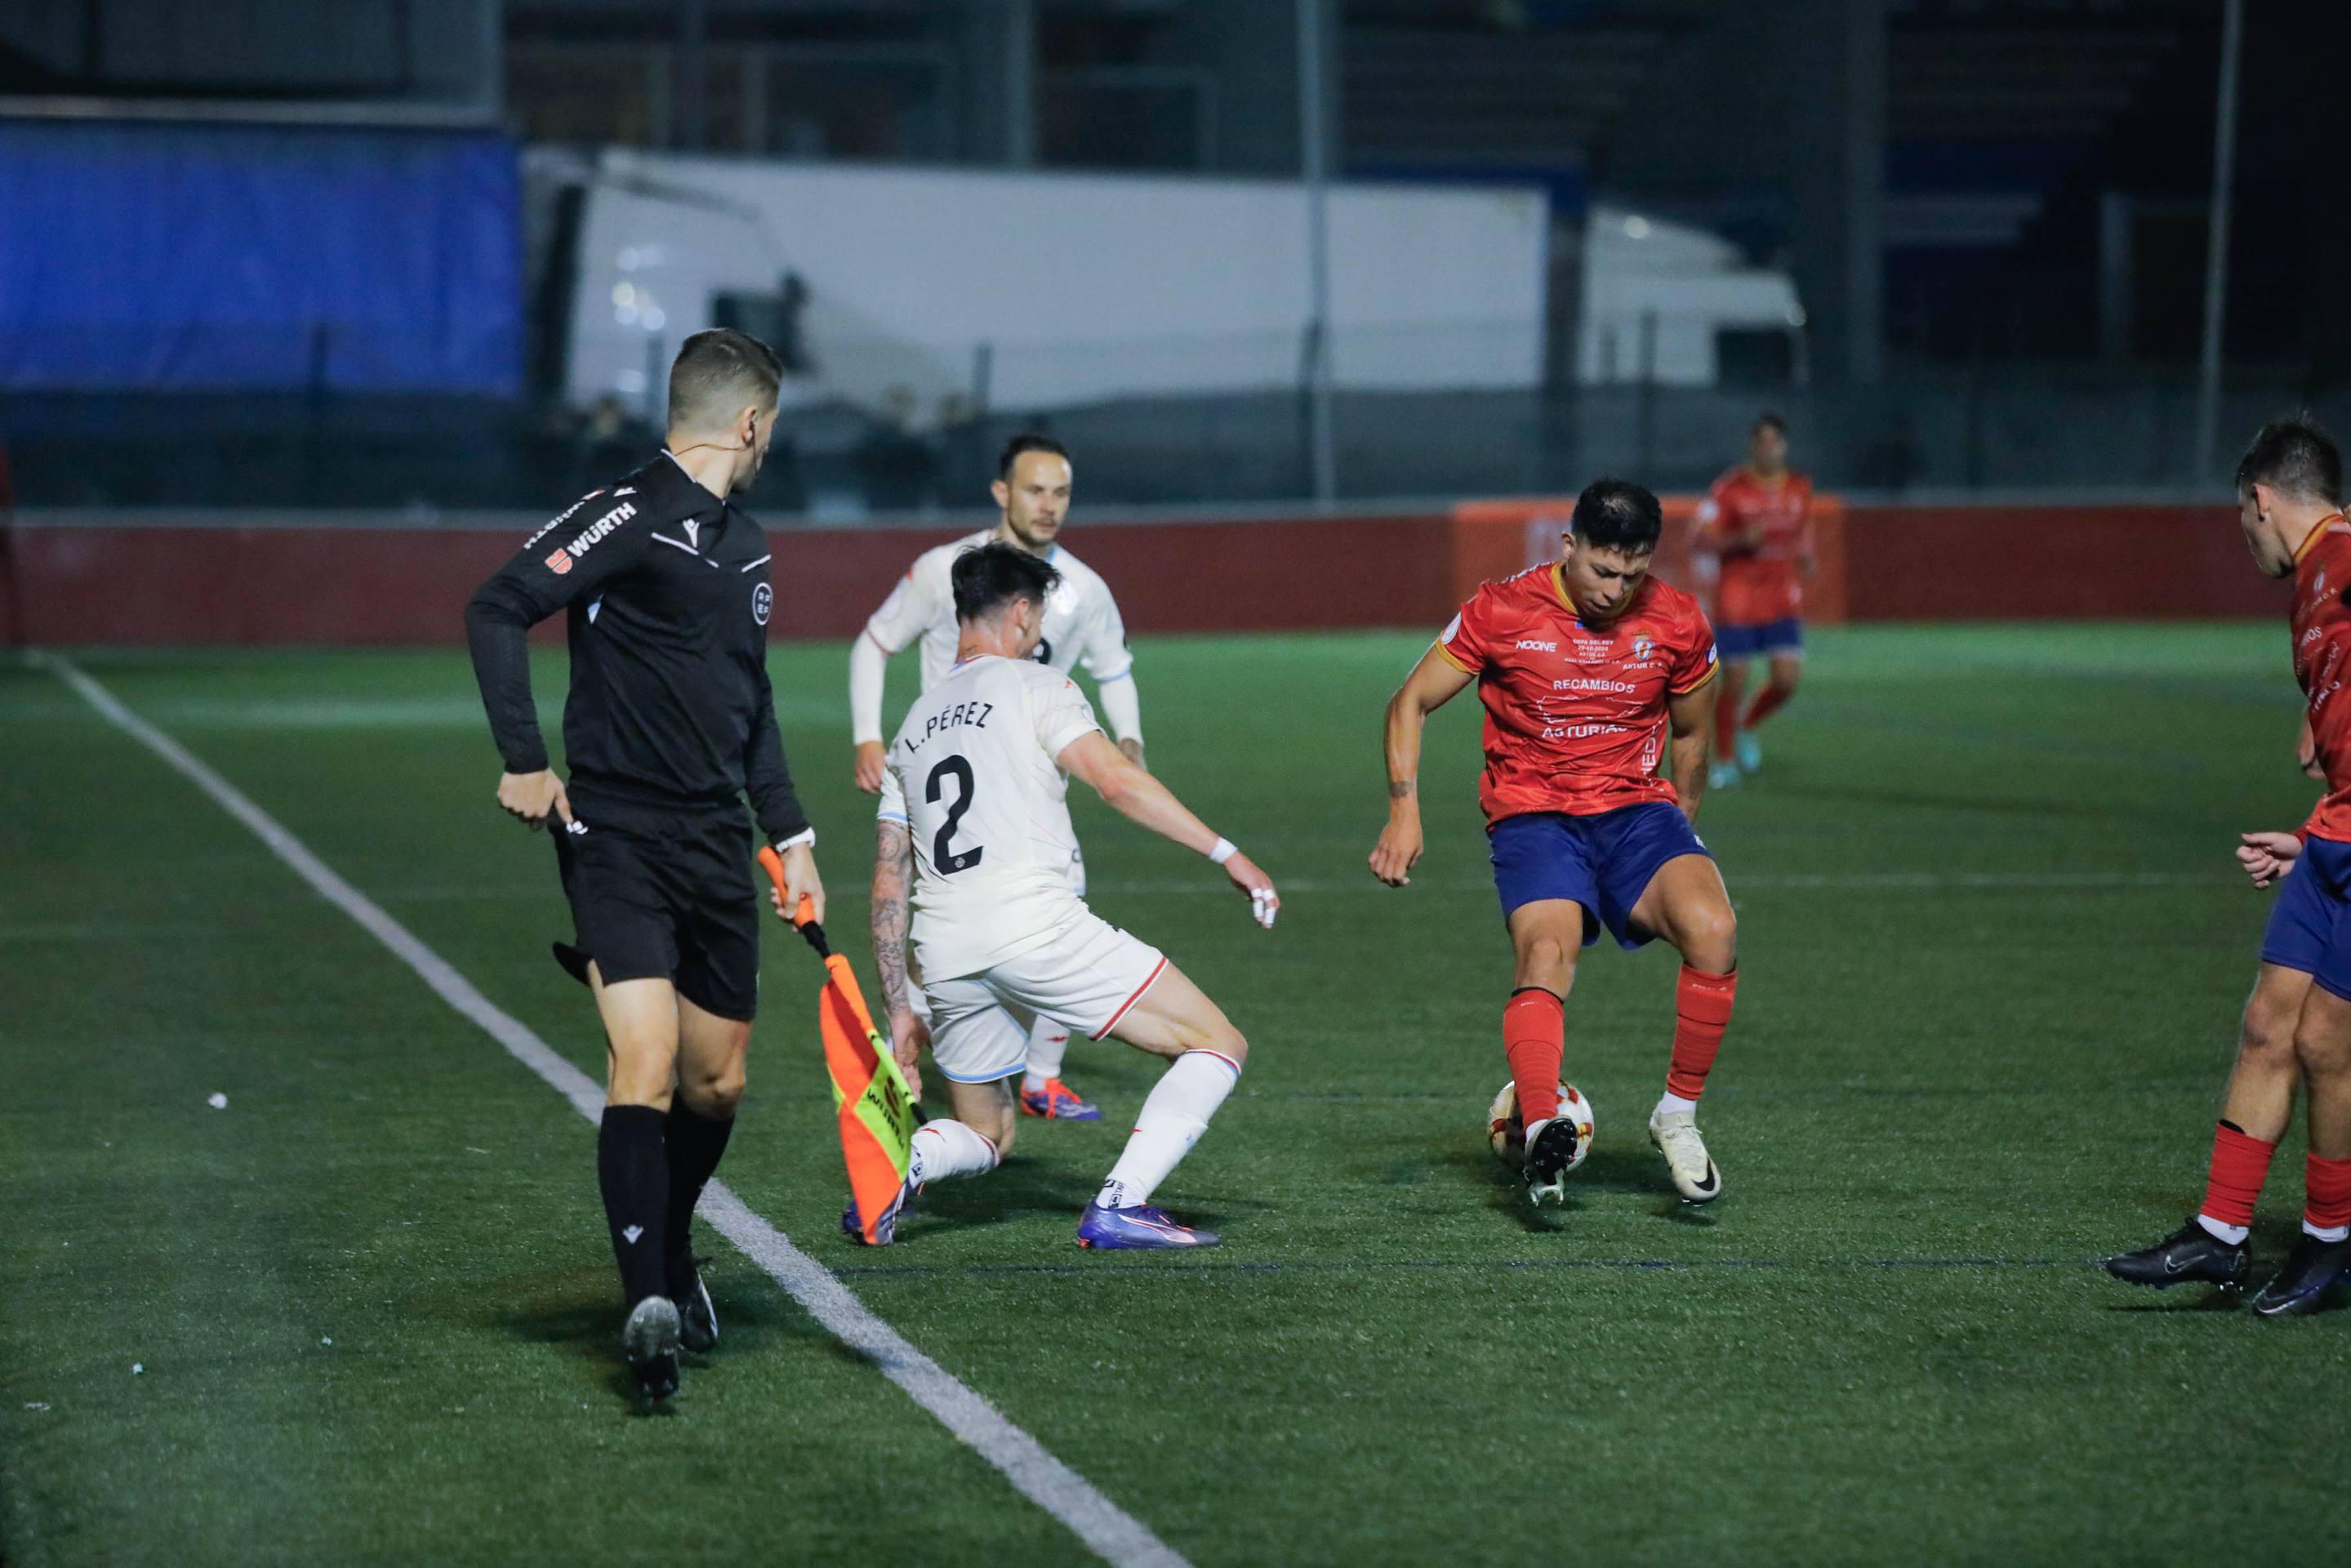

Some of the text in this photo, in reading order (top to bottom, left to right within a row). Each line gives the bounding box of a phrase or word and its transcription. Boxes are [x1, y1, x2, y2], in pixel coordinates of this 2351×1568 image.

[567, 501, 638, 557] WÜRTH
[1516, 640, 1557, 653] NOONE
[1553, 679, 1636, 693] RECAMBIOS
[925, 755, 984, 876] 2
